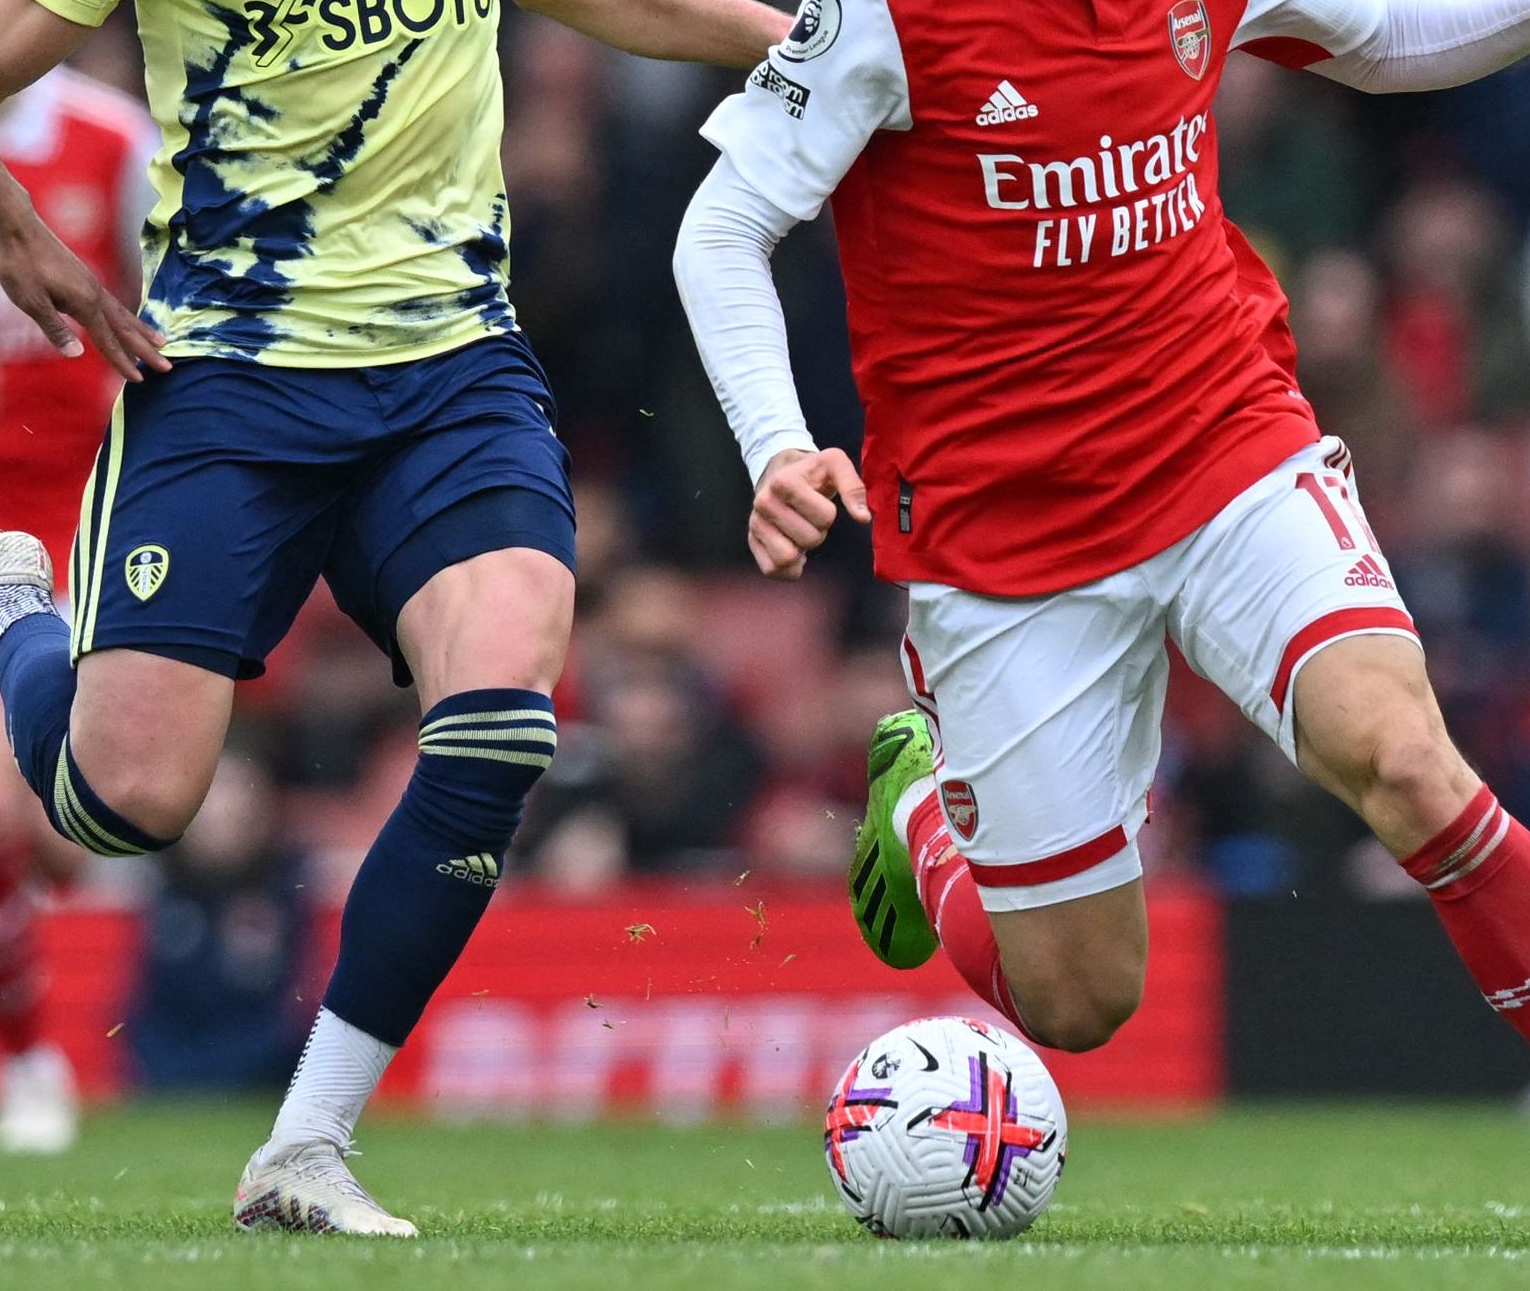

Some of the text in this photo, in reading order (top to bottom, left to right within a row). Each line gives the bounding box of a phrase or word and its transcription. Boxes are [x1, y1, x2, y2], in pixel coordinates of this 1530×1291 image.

[1172, 9, 1204, 30] Arsenal
[975, 104, 1039, 126] adidas
[1033, 172, 1206, 268] FLY BETTER
